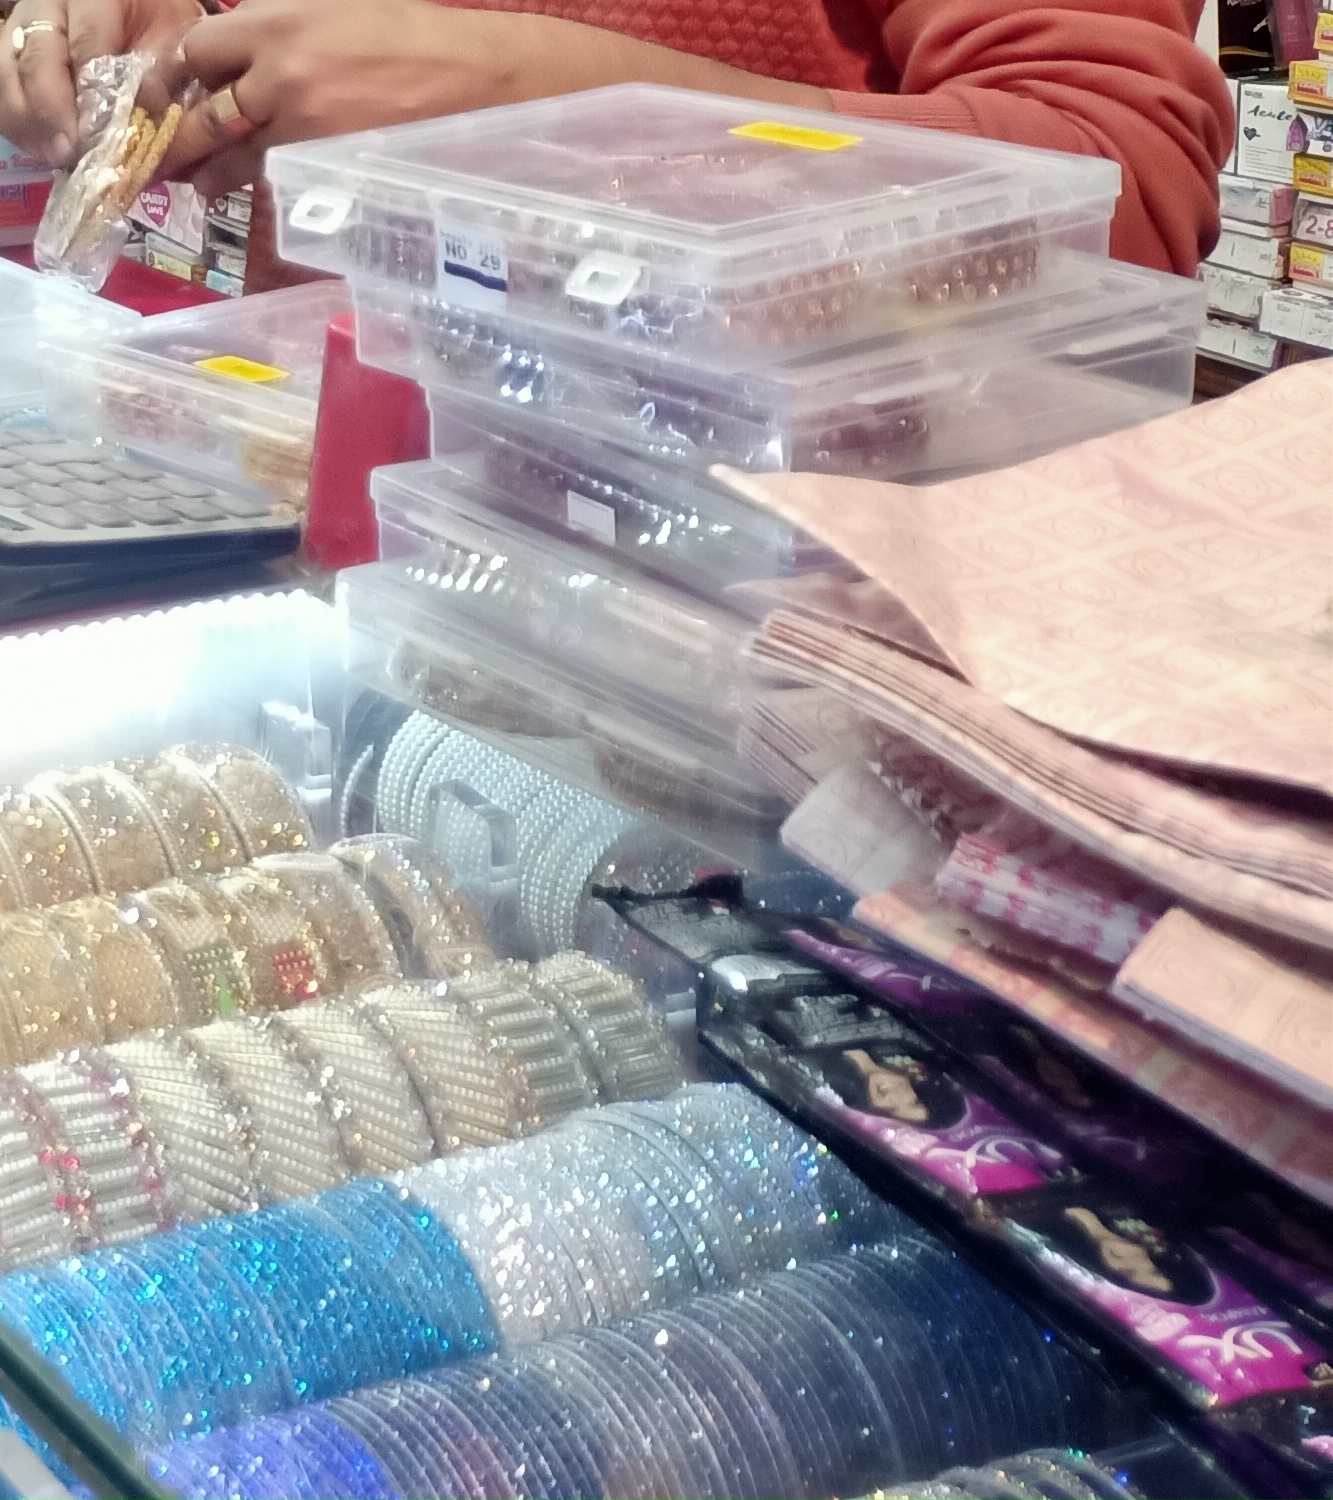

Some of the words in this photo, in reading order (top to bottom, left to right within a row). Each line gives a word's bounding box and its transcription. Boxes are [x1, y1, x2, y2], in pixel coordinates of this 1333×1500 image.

[141, 192, 168, 206] CANDY
[445, 240, 467, 260] NO
[478, 251, 501, 271] 29
